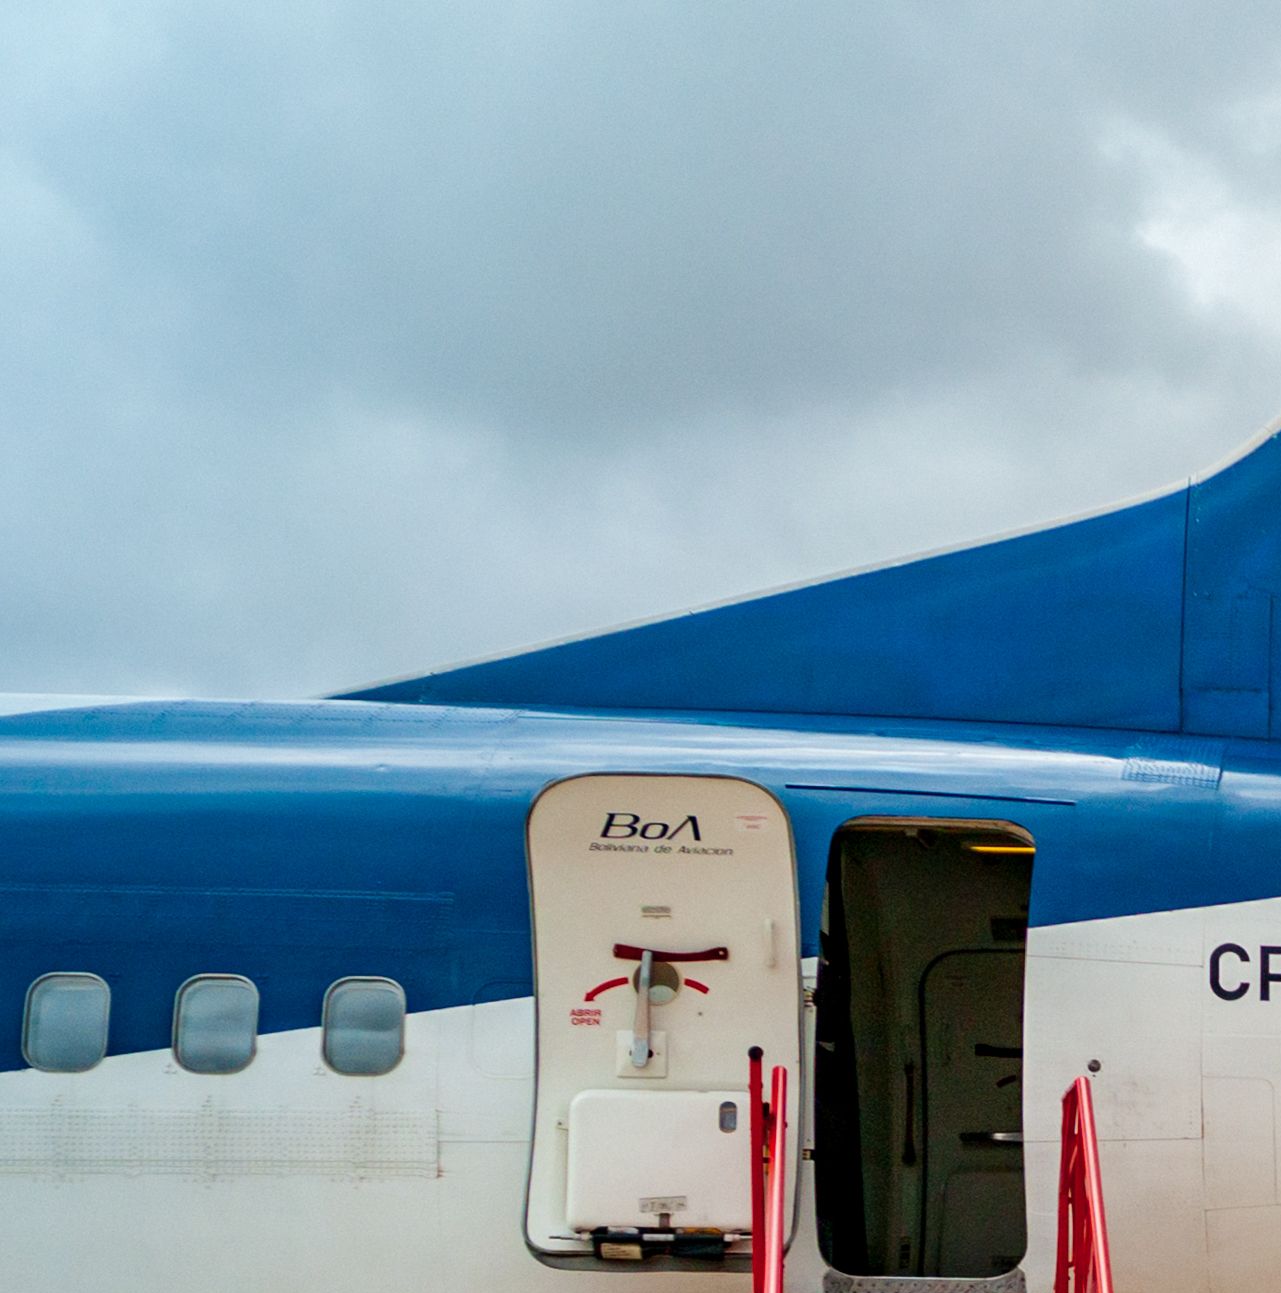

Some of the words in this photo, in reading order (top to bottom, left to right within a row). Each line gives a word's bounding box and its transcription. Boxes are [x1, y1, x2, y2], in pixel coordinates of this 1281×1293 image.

[600, 812, 702, 842] BoA
[589, 842, 649, 854] Boliviana
[654, 844, 672, 854] de
[570, 1009, 602, 1017] ABRIR
[571, 1017, 601, 1026] OPEN
